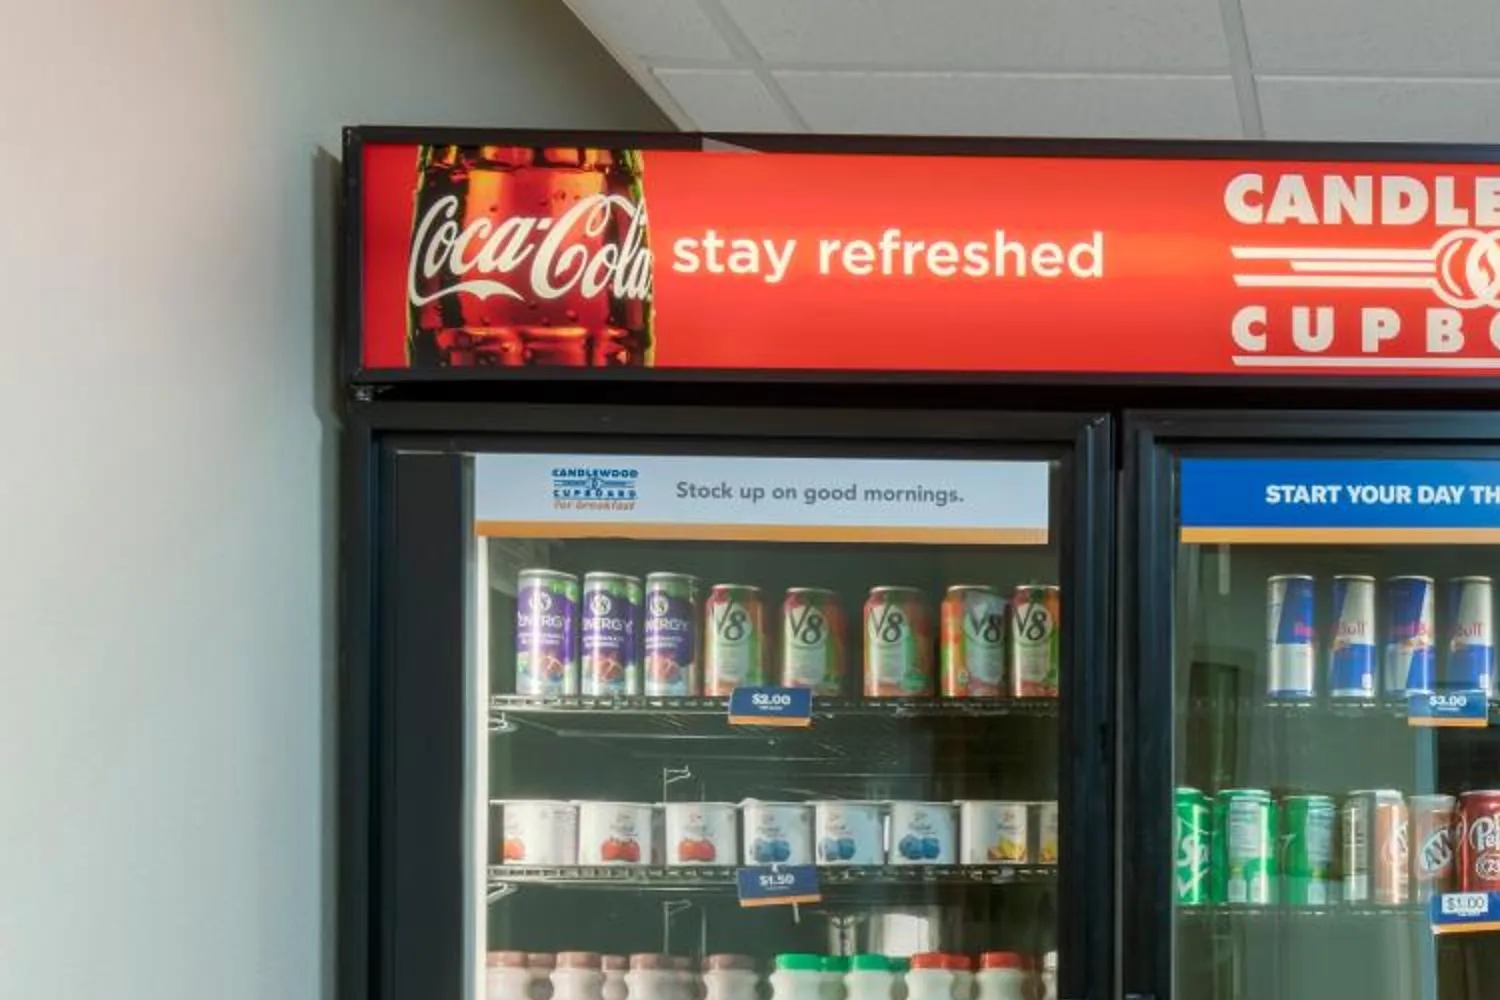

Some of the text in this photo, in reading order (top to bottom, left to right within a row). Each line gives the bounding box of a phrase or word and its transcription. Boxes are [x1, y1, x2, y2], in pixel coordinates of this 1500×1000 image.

[410, 194, 654, 305] Coca-Cola
[672, 228, 1105, 283] stay refreshed
[552, 467, 638, 478] CANDLEWOOD
[553, 488, 636, 498] CUPBOARD
[676, 481, 965, 506] Stock up on good mornings.
[1265, 485, 1341, 504] START
[1347, 485, 1412, 504] YOUR
[1418, 485, 1464, 504] DAY
[713, 600, 748, 641] V8
[790, 603, 823, 644] V8
[870, 603, 904, 643] V8
[966, 602, 1000, 643] V8
[1016, 602, 1047, 641] V8
[1447, 896, 1485, 911] $1.00
